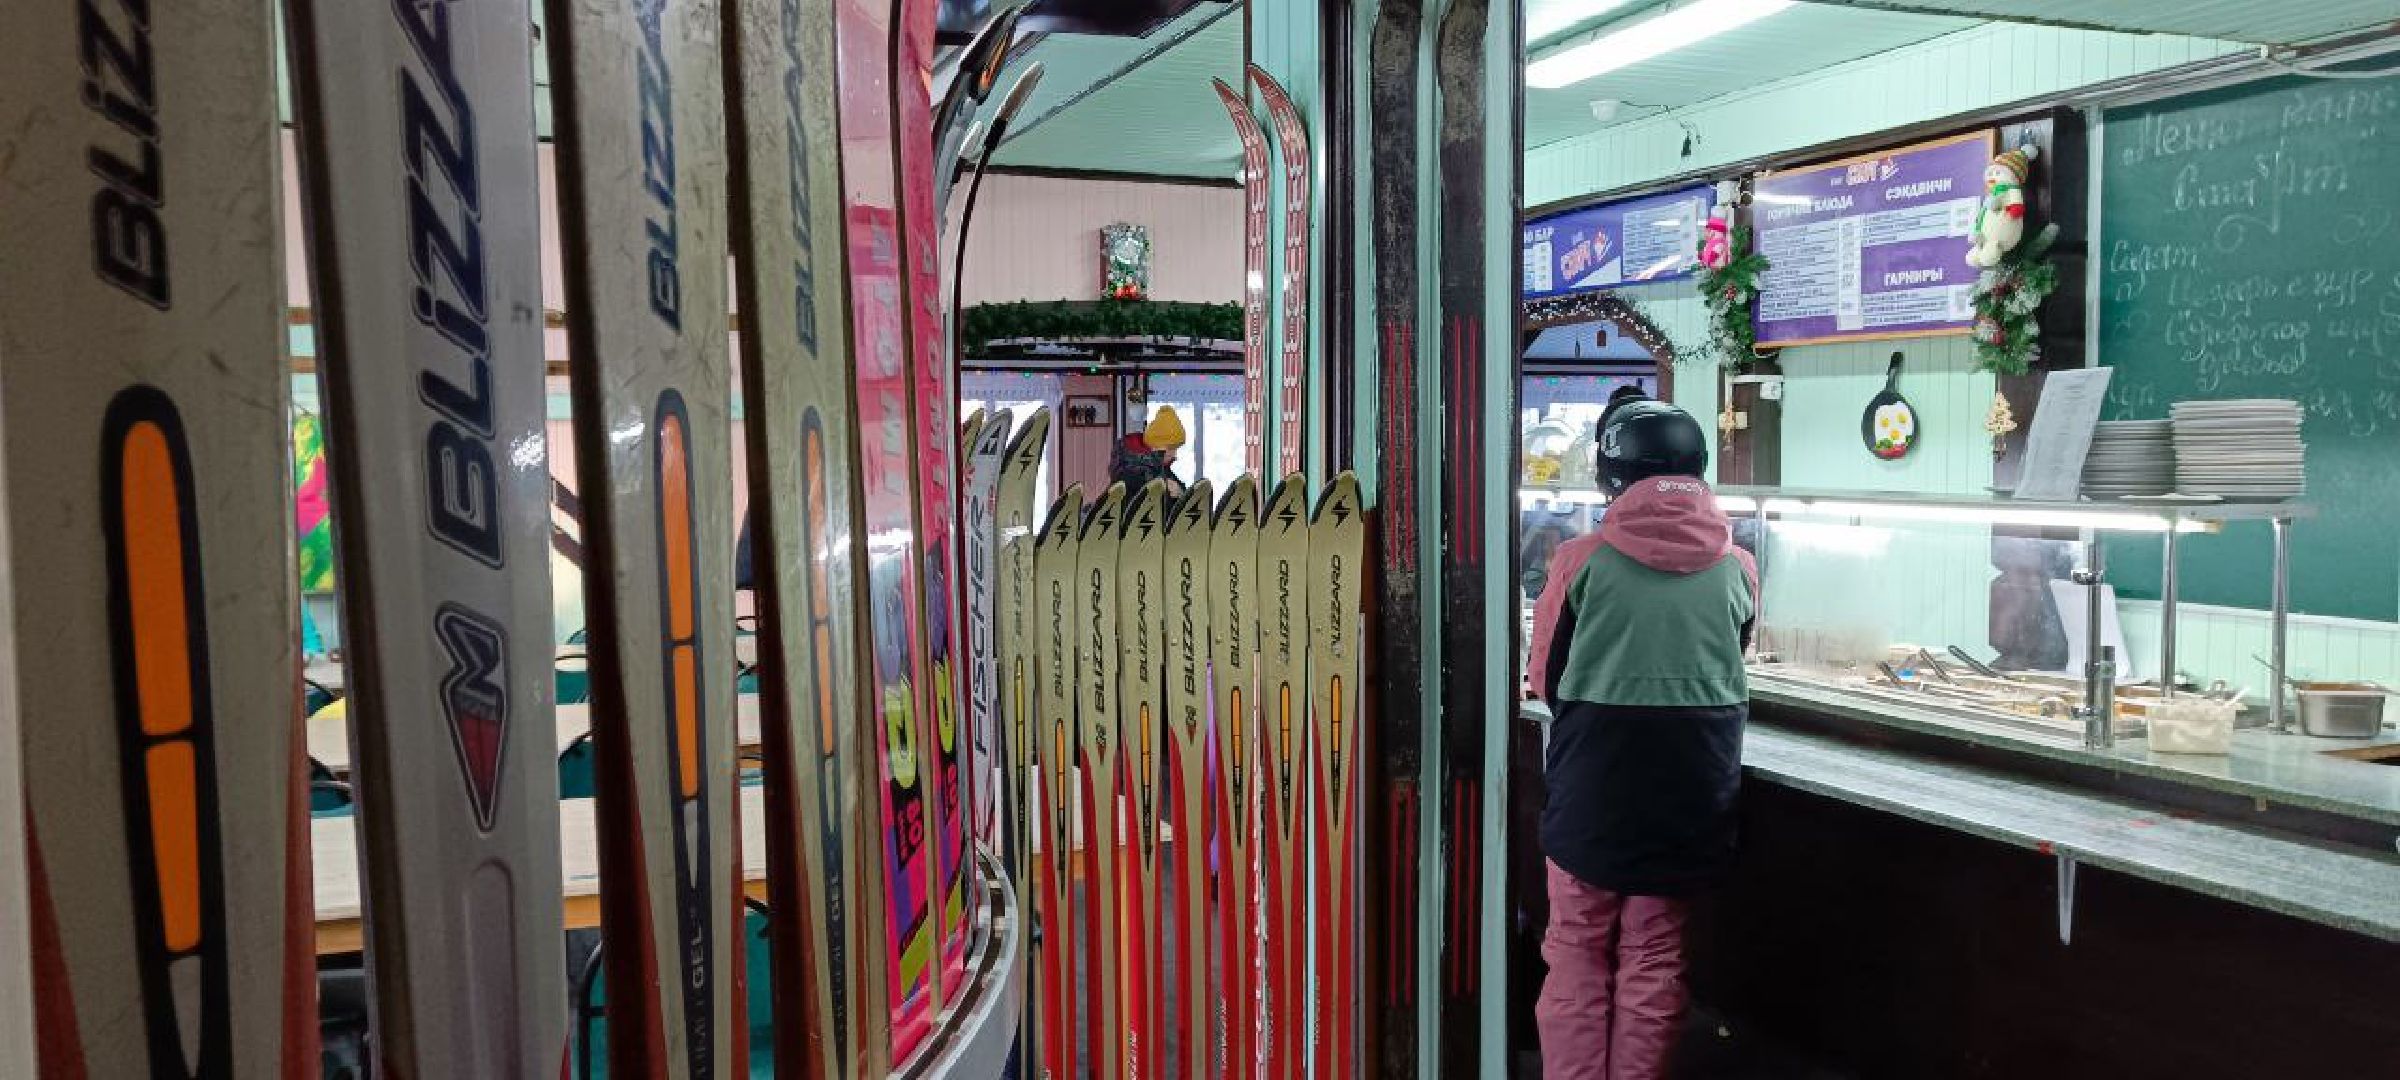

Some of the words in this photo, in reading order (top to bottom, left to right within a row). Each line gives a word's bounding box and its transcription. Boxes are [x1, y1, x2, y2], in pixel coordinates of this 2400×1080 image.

[1883, 267, 1943, 287] ГАРНИРЫ
[968, 494, 990, 756] FISCHER
[1051, 580, 1064, 699] BLIZZARD
[1091, 567, 1105, 714] BLIZZARD
[1137, 569, 1149, 683] BLIZZARD
[1181, 557, 1196, 695] BLIZZARD
[1229, 561, 1240, 668] BLIZZARD
